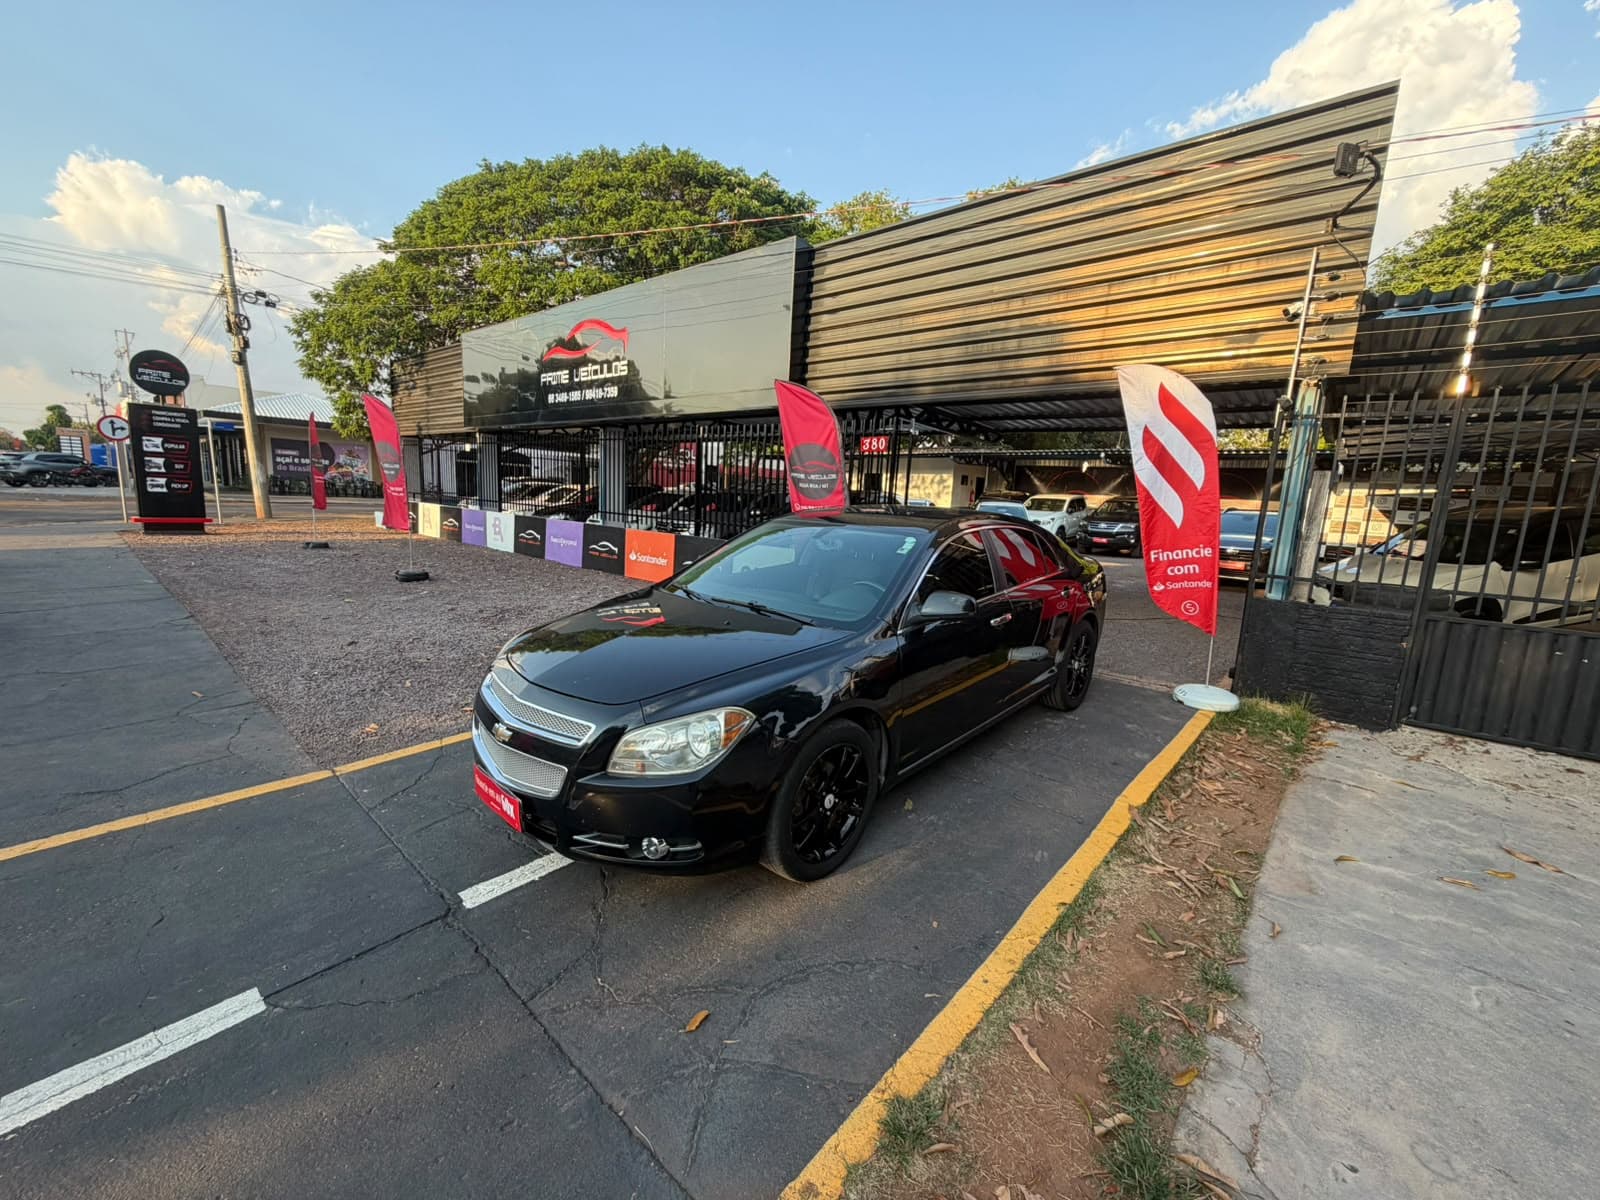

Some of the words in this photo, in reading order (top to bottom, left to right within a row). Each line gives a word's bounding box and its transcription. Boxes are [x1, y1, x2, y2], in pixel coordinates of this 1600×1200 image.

[573, 360, 628, 382] VEÍCULOS
[863, 438, 886, 450] 380
[636, 552, 668, 566] Santander
[1150, 544, 1212, 563] Financie
[1167, 563, 1200, 576] com
